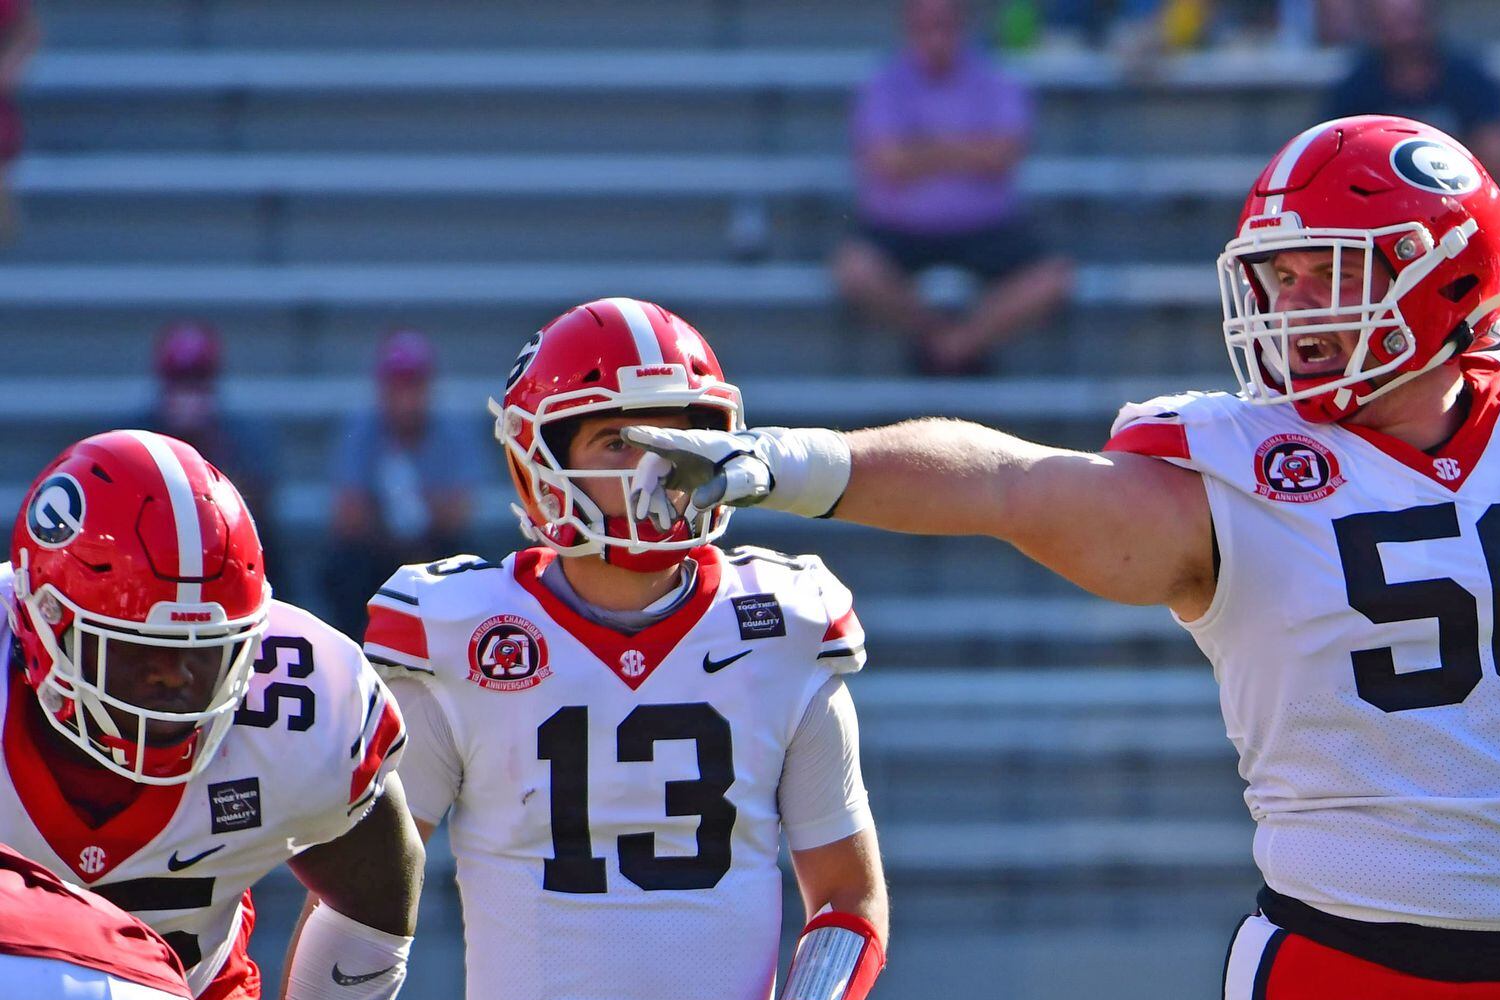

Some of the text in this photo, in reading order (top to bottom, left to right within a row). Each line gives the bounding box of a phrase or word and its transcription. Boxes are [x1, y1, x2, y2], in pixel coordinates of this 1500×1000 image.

[1432, 457, 1461, 480] SEC
[27, 474, 83, 546] G
[737, 601, 778, 610] TOGETHER
[472, 615, 542, 641] NATIONAL CHAMPIONS
[742, 618, 780, 628] EQUALITY
[619, 650, 646, 677] SEC
[485, 678, 534, 690] ANNIVERSARY
[537, 701, 737, 894] 13
[216, 810, 257, 823] EQUALITY
[79, 846, 106, 874] SEC
